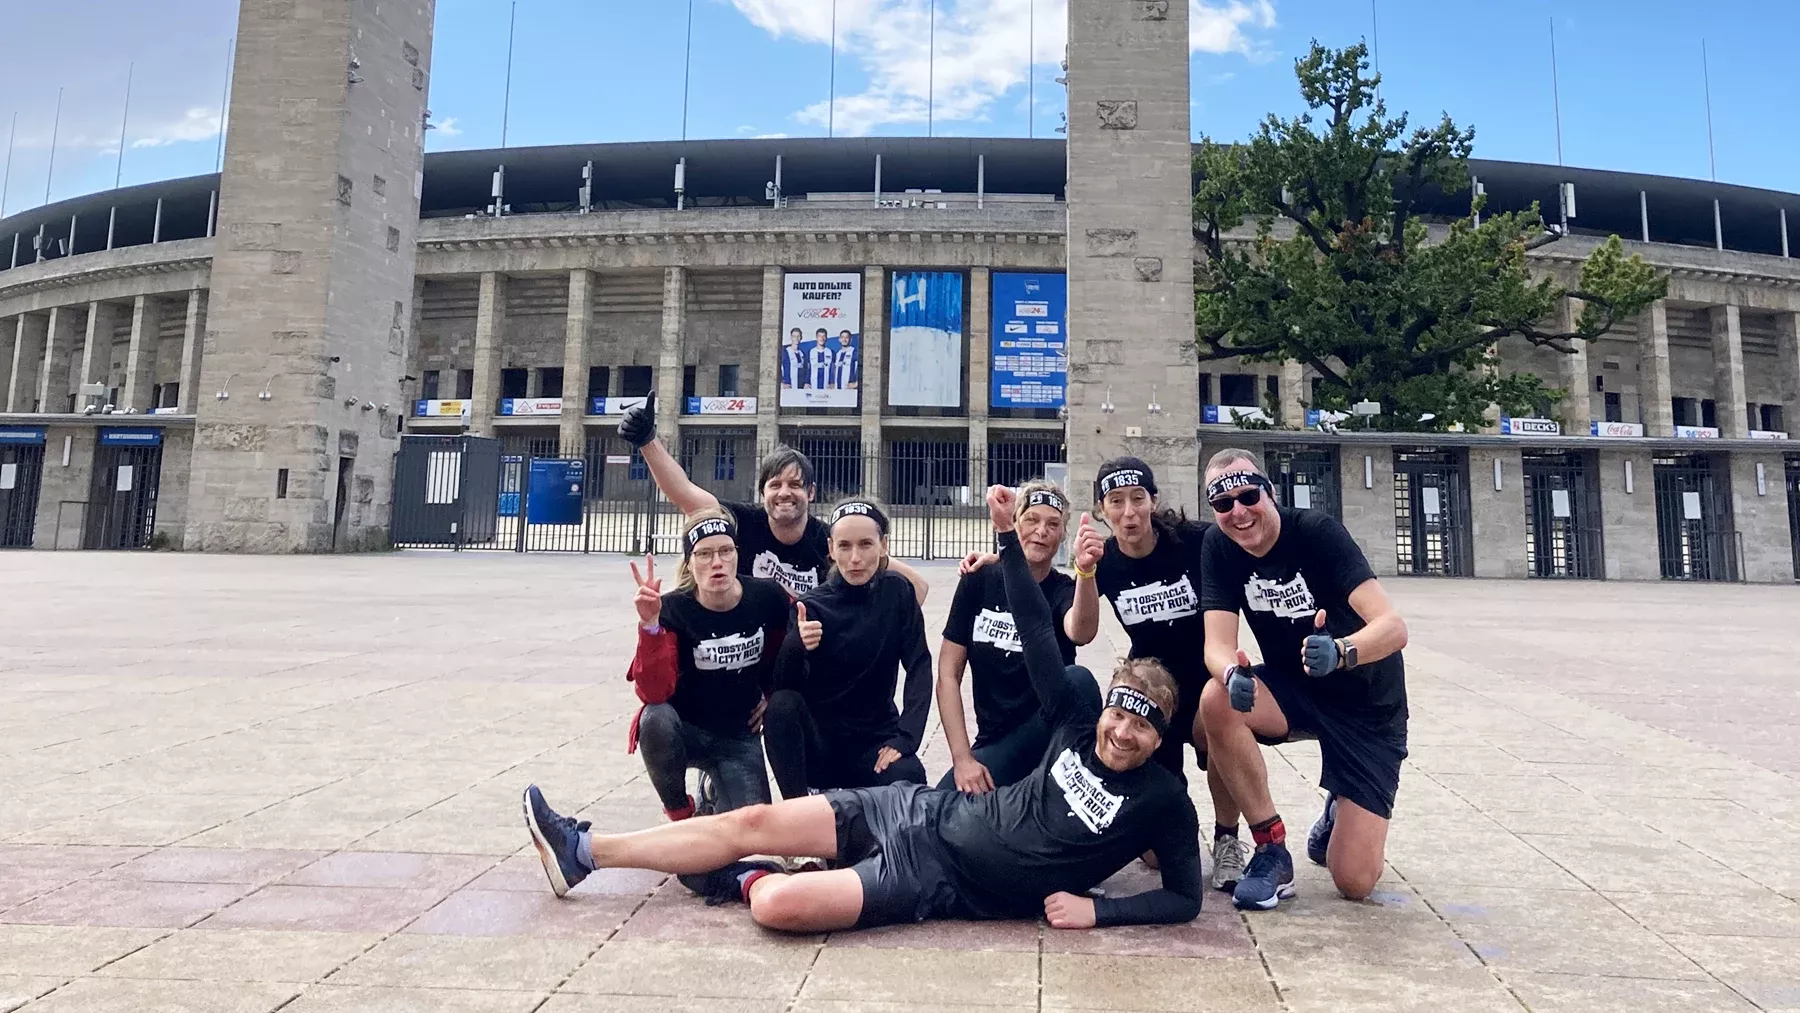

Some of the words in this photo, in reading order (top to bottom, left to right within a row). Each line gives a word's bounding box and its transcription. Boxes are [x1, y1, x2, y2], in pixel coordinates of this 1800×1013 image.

[793, 282, 816, 290] AUTO
[818, 282, 852, 290] ONLINE
[802, 292, 842, 300] KAUFEN?
[1524, 422, 1557, 432] BECK'S
[1113, 474, 1139, 487] 1835
[1220, 475, 1249, 492] 1845
[1139, 585, 1187, 605] OBSTACLE
[1261, 583, 1304, 599] OBSACLE
[1140, 601, 1165, 615] CITY
[1167, 594, 1190, 610] RUN
[1285, 593, 1307, 610] RUN
[989, 628, 1012, 641] CITY
[717, 636, 761, 654] OBSTACLE
[719, 652, 741, 664] CITY
[743, 645, 760, 659] RUN
[1122, 694, 1150, 717] 1840
[1066, 777, 1088, 801] CITY
[1084, 797, 1107, 820] RUN
[1074, 771, 1114, 811] OBSTACLE
